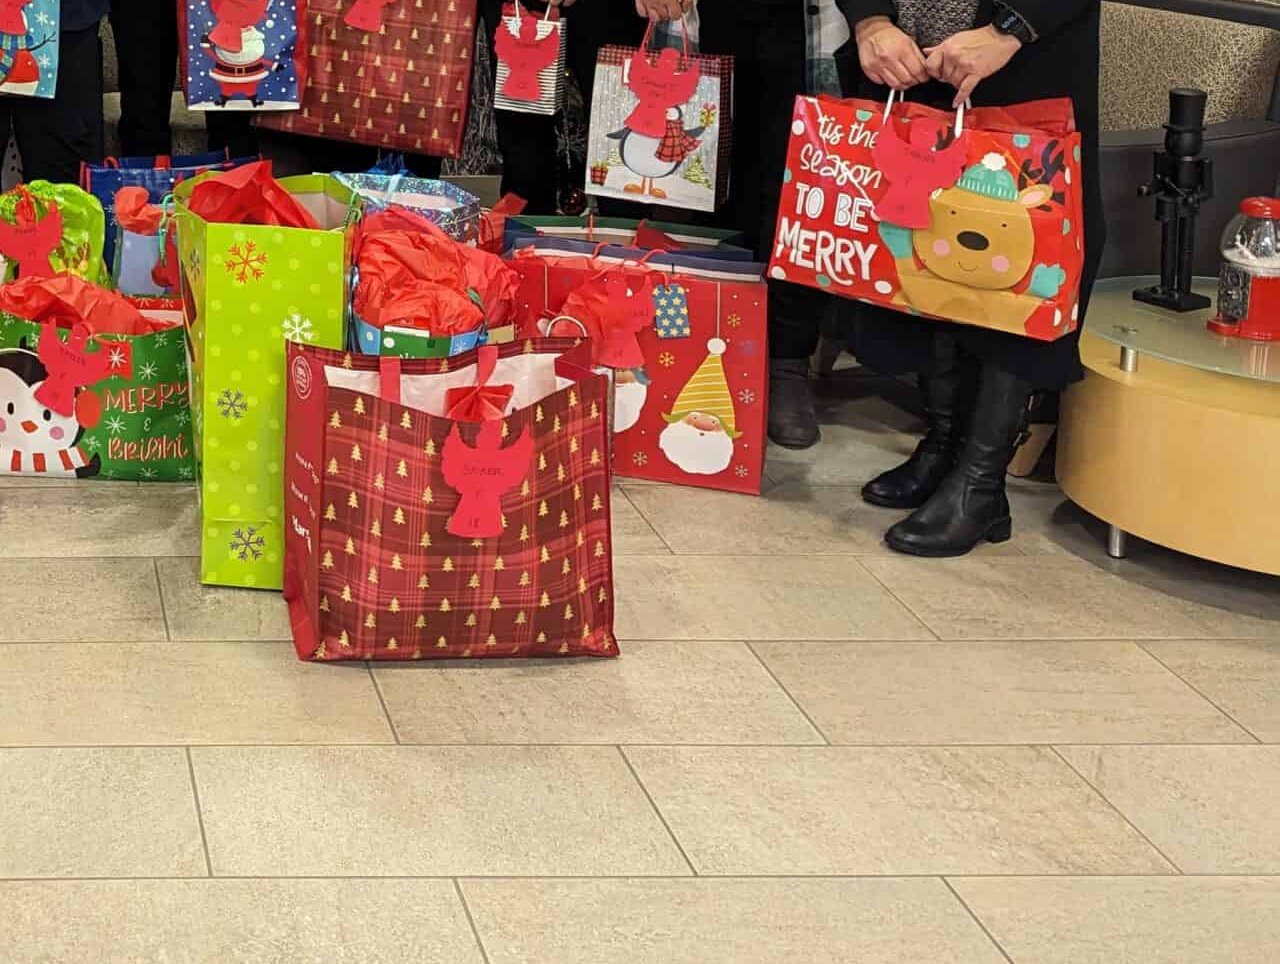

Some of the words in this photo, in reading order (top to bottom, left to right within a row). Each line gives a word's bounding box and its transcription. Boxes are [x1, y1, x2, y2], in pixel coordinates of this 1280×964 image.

[800, 142, 883, 189] season
[795, 182, 825, 219] TO
[833, 192, 870, 233] BE
[775, 216, 878, 286] MERRY
[104, 381, 190, 414] MERRY
